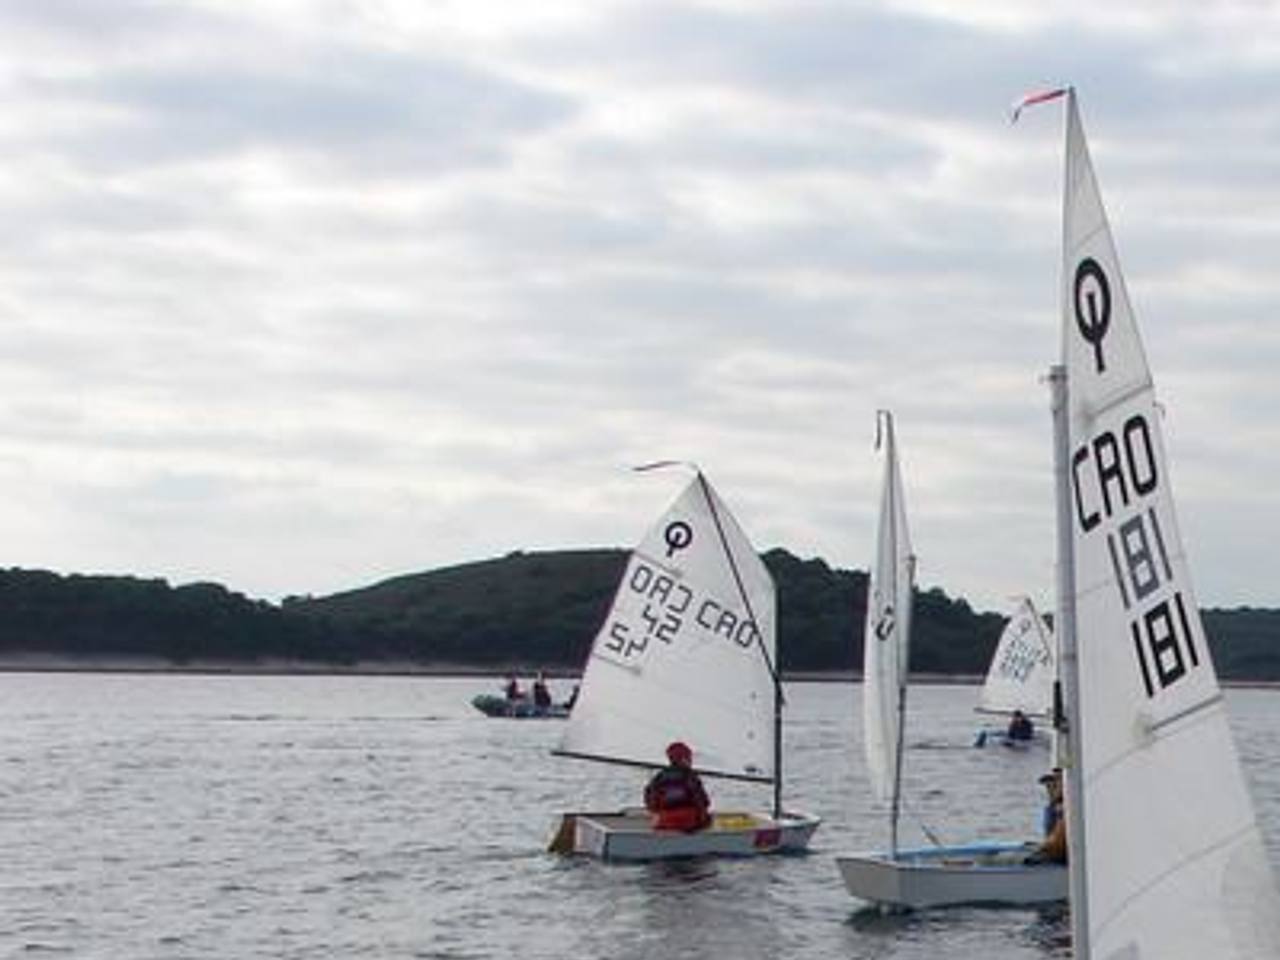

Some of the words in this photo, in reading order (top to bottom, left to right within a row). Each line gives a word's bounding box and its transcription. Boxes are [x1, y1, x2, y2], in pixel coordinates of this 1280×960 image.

[1071, 414, 1158, 533] CRO
[1107, 507, 1173, 610] 181
[695, 599, 757, 648] CRO
[1130, 592, 1200, 698] 181
